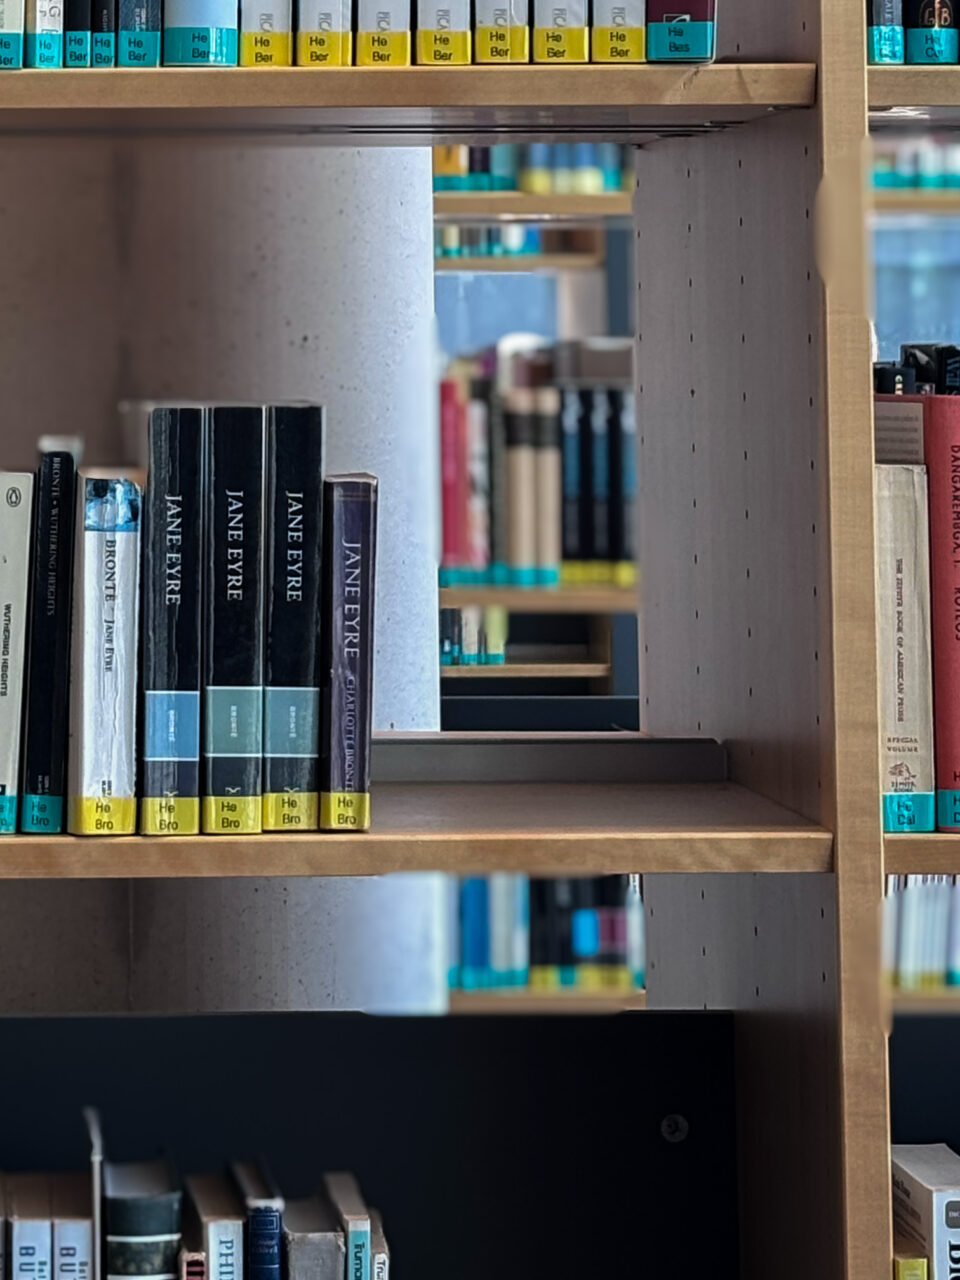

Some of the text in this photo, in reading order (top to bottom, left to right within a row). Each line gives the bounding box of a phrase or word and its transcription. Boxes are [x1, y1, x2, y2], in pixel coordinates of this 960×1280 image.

[343, 538, 361, 658] JANE EYRE
[0, 604, 12, 696] WUTHERING HEIGHTS
[221, 802, 237, 812] He
